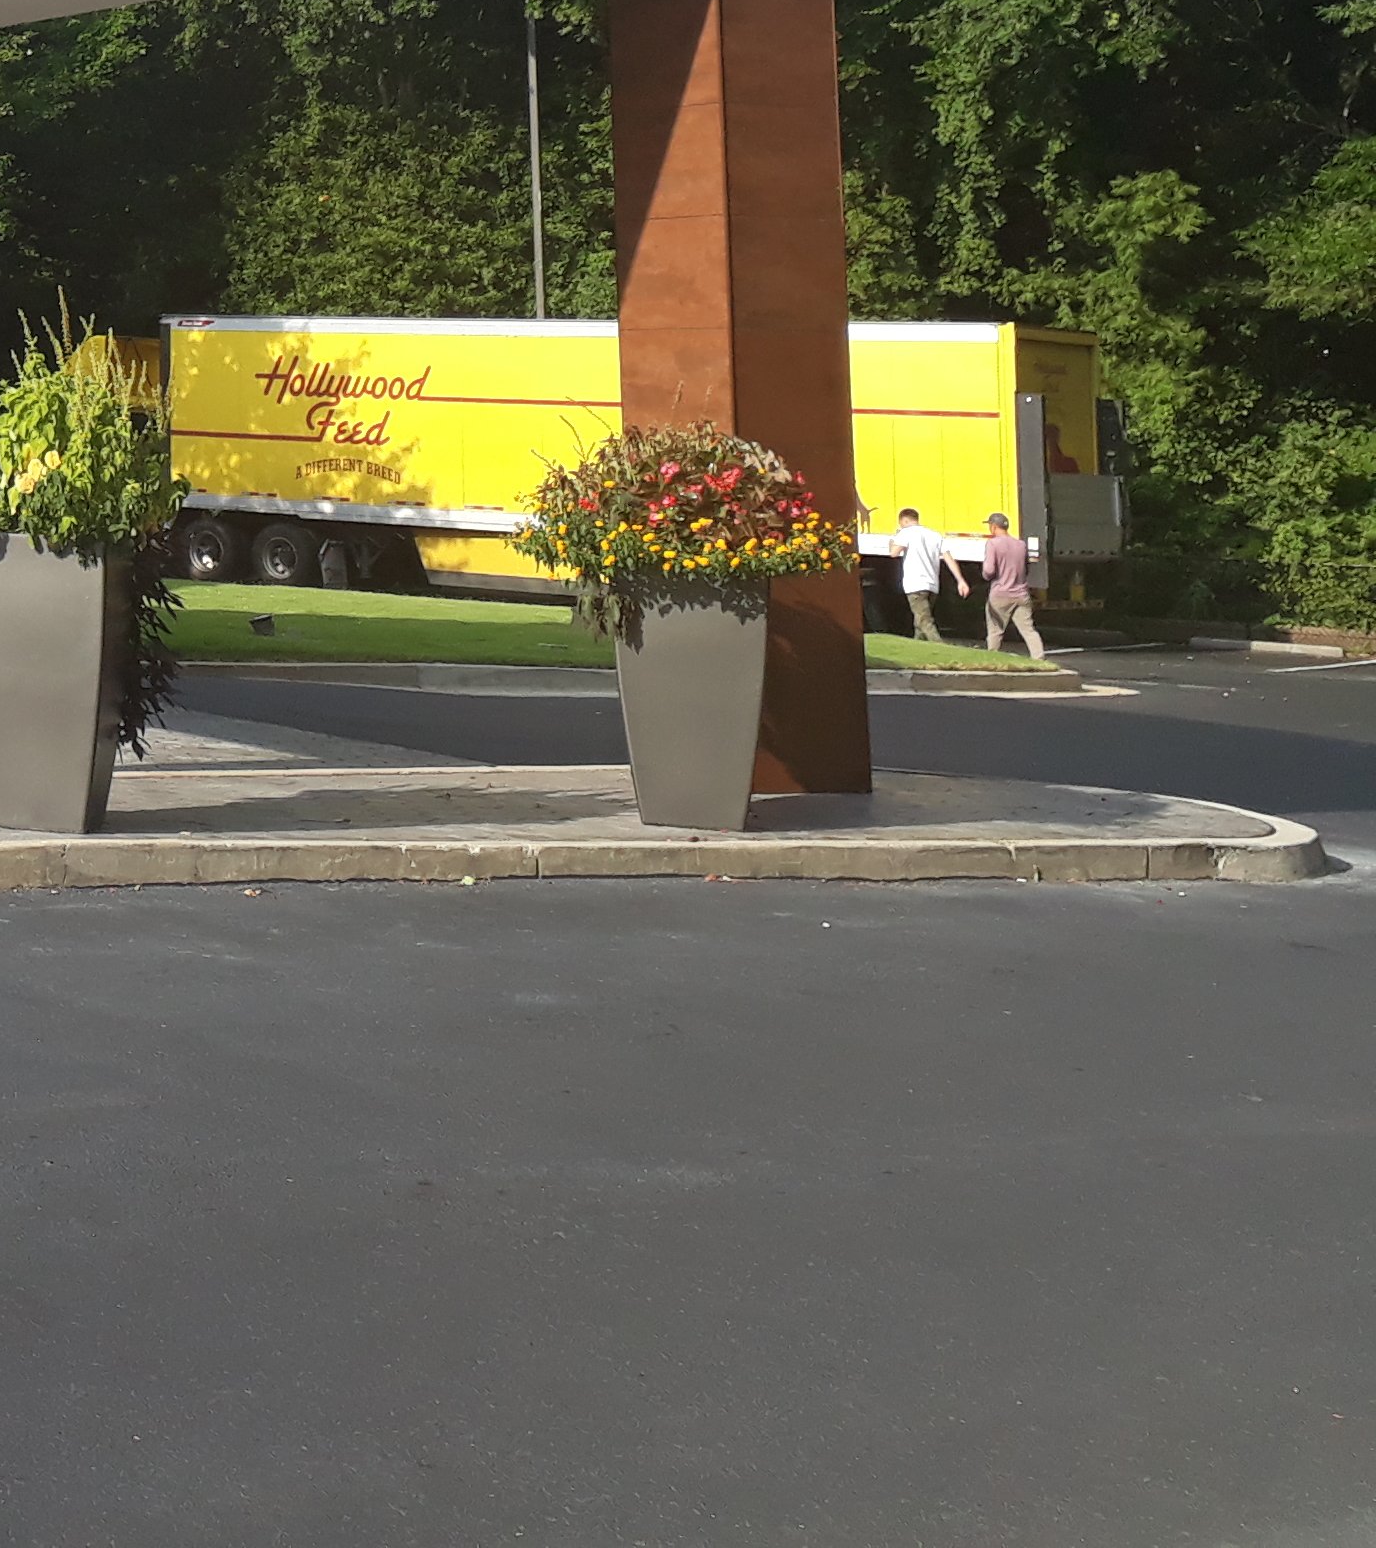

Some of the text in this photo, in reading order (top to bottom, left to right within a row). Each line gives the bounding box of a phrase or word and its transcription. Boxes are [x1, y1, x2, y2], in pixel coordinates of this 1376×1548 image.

[255, 355, 431, 404] Hollywood
[306, 401, 390, 445] Feed
[295, 458, 401, 485] A DIFFERENT BREED
